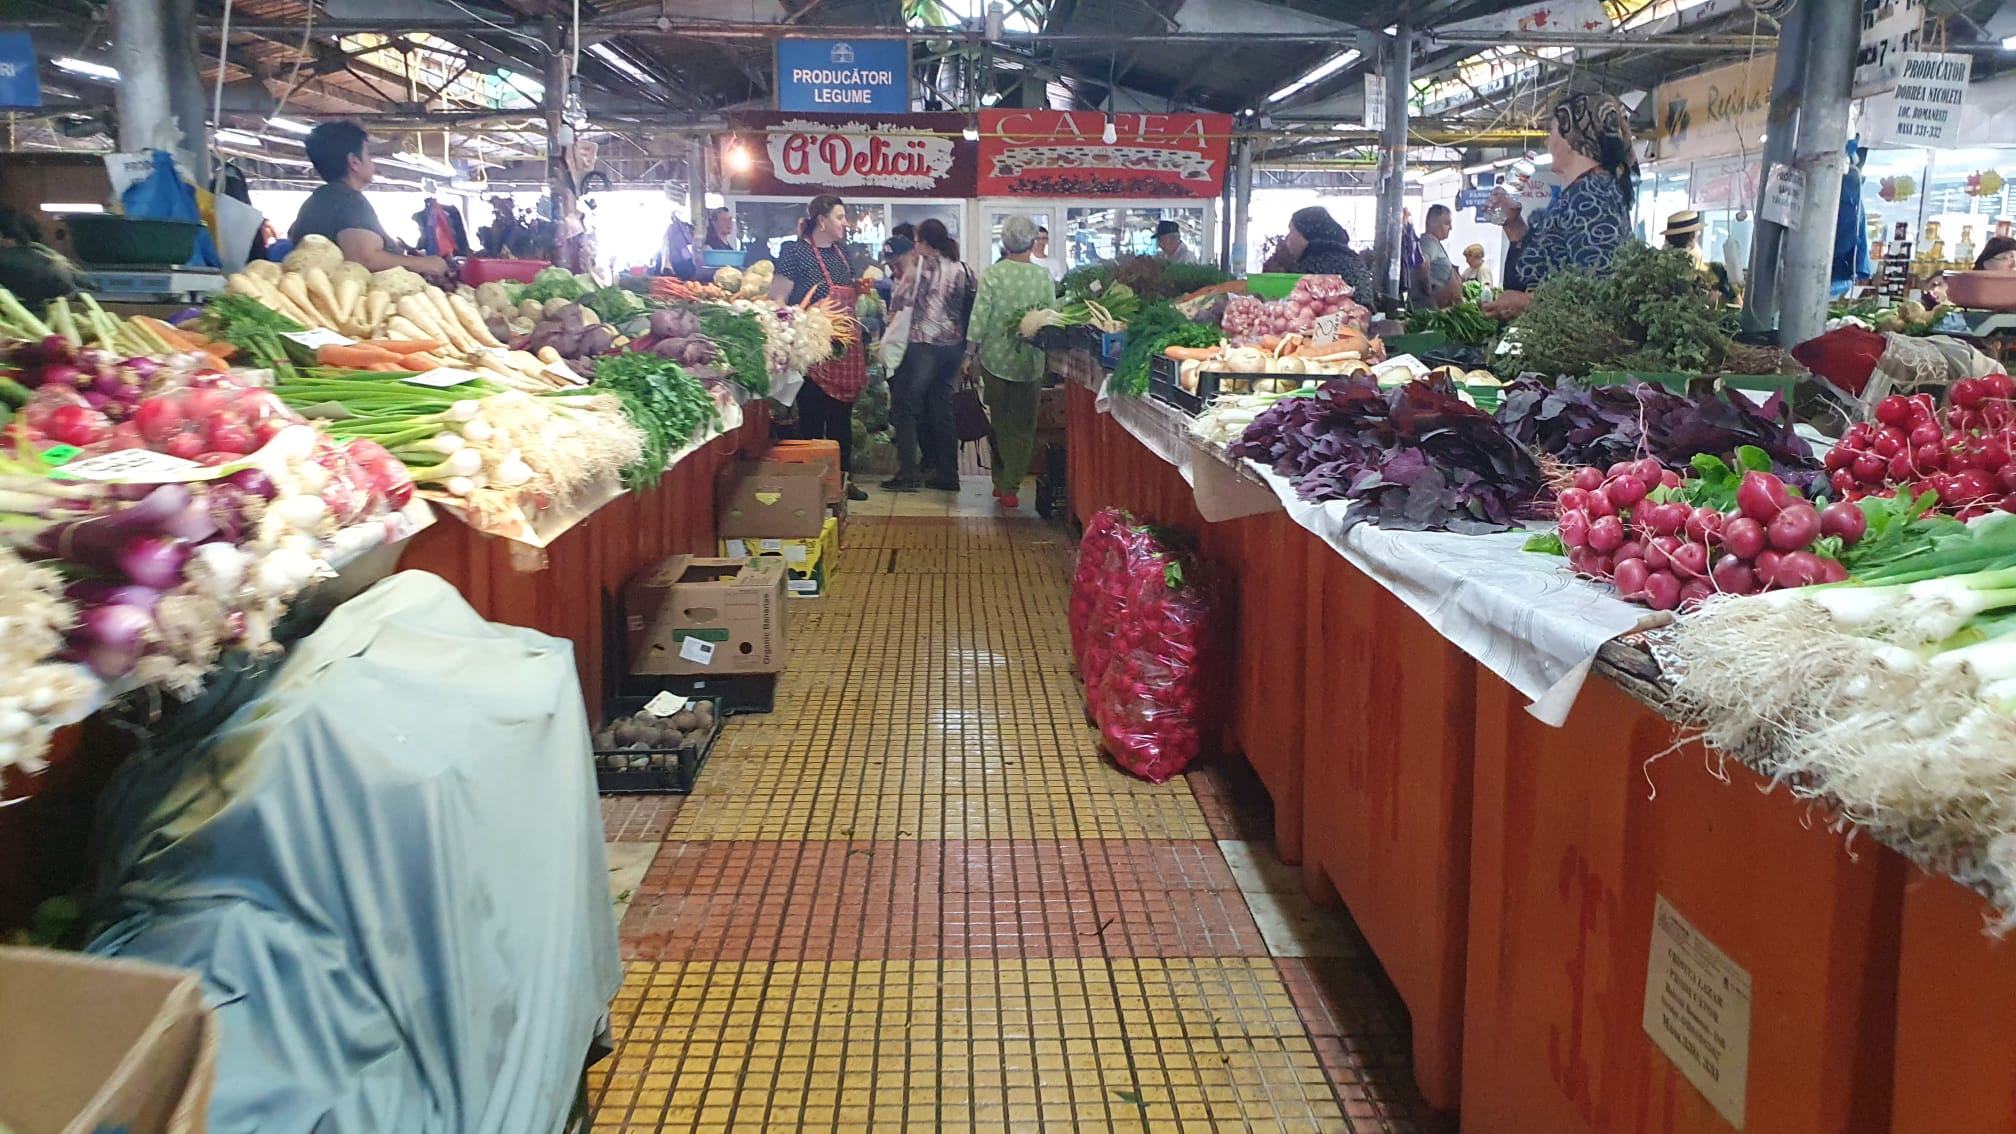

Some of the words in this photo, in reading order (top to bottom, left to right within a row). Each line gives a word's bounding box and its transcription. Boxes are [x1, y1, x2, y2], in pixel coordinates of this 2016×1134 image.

[1880, 39, 1888, 67] 7
[793, 68, 892, 86] PRODUCĂTORI
[1903, 59, 1966, 82] PRODUCATOR
[814, 89, 872, 104] LEGUME
[1895, 84, 1926, 101] DOBREA
[1928, 86, 1963, 105] NICOLETA
[1896, 123, 1913, 135] MASA
[762, 593, 771, 629] Bananas
[762, 632, 772, 665] Organic
